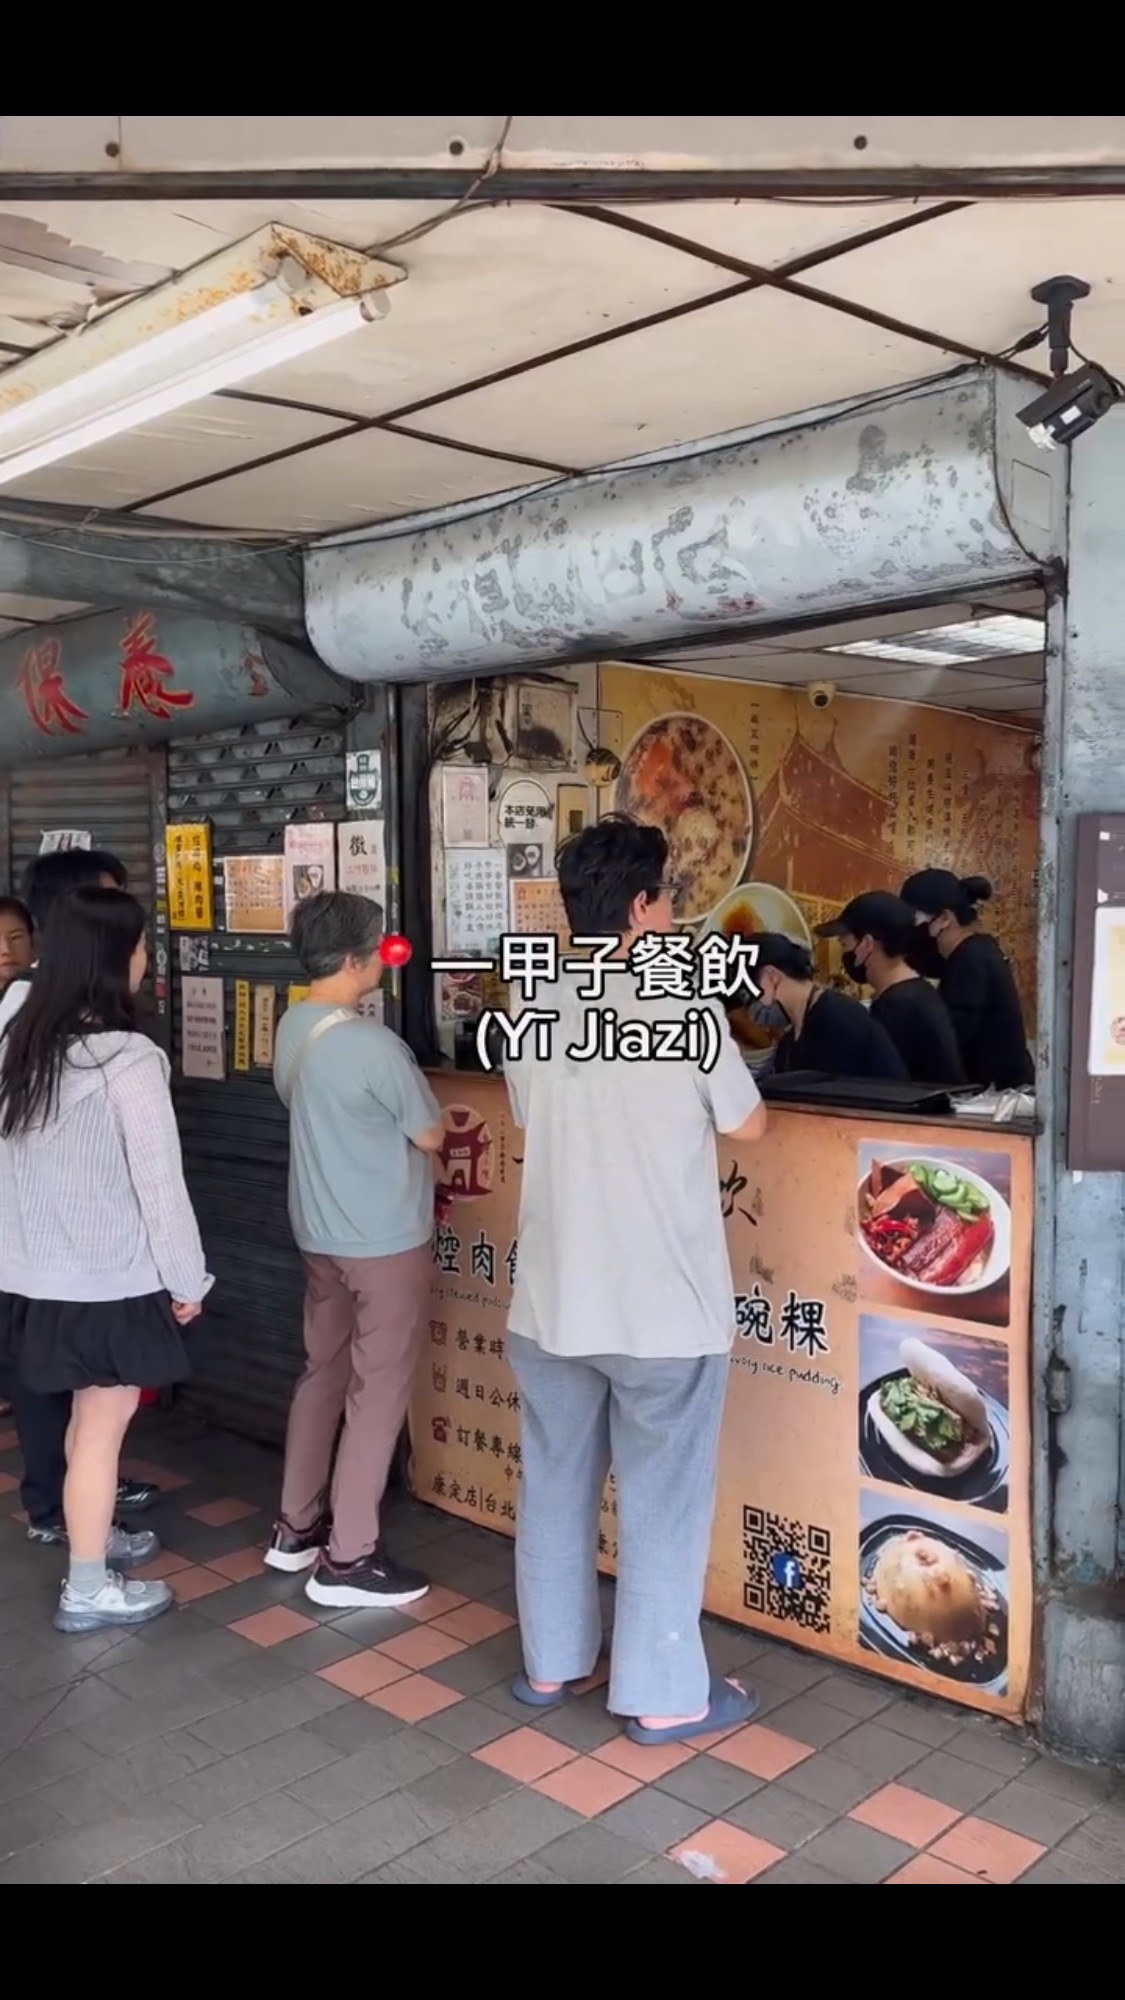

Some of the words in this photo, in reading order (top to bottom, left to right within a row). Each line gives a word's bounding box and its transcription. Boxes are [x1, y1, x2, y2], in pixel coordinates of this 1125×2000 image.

[455, 1377, 521, 1413] 週日公休
[789, 1366, 840, 1395] pudding
[455, 1425, 523, 1464] 訂餐專線
